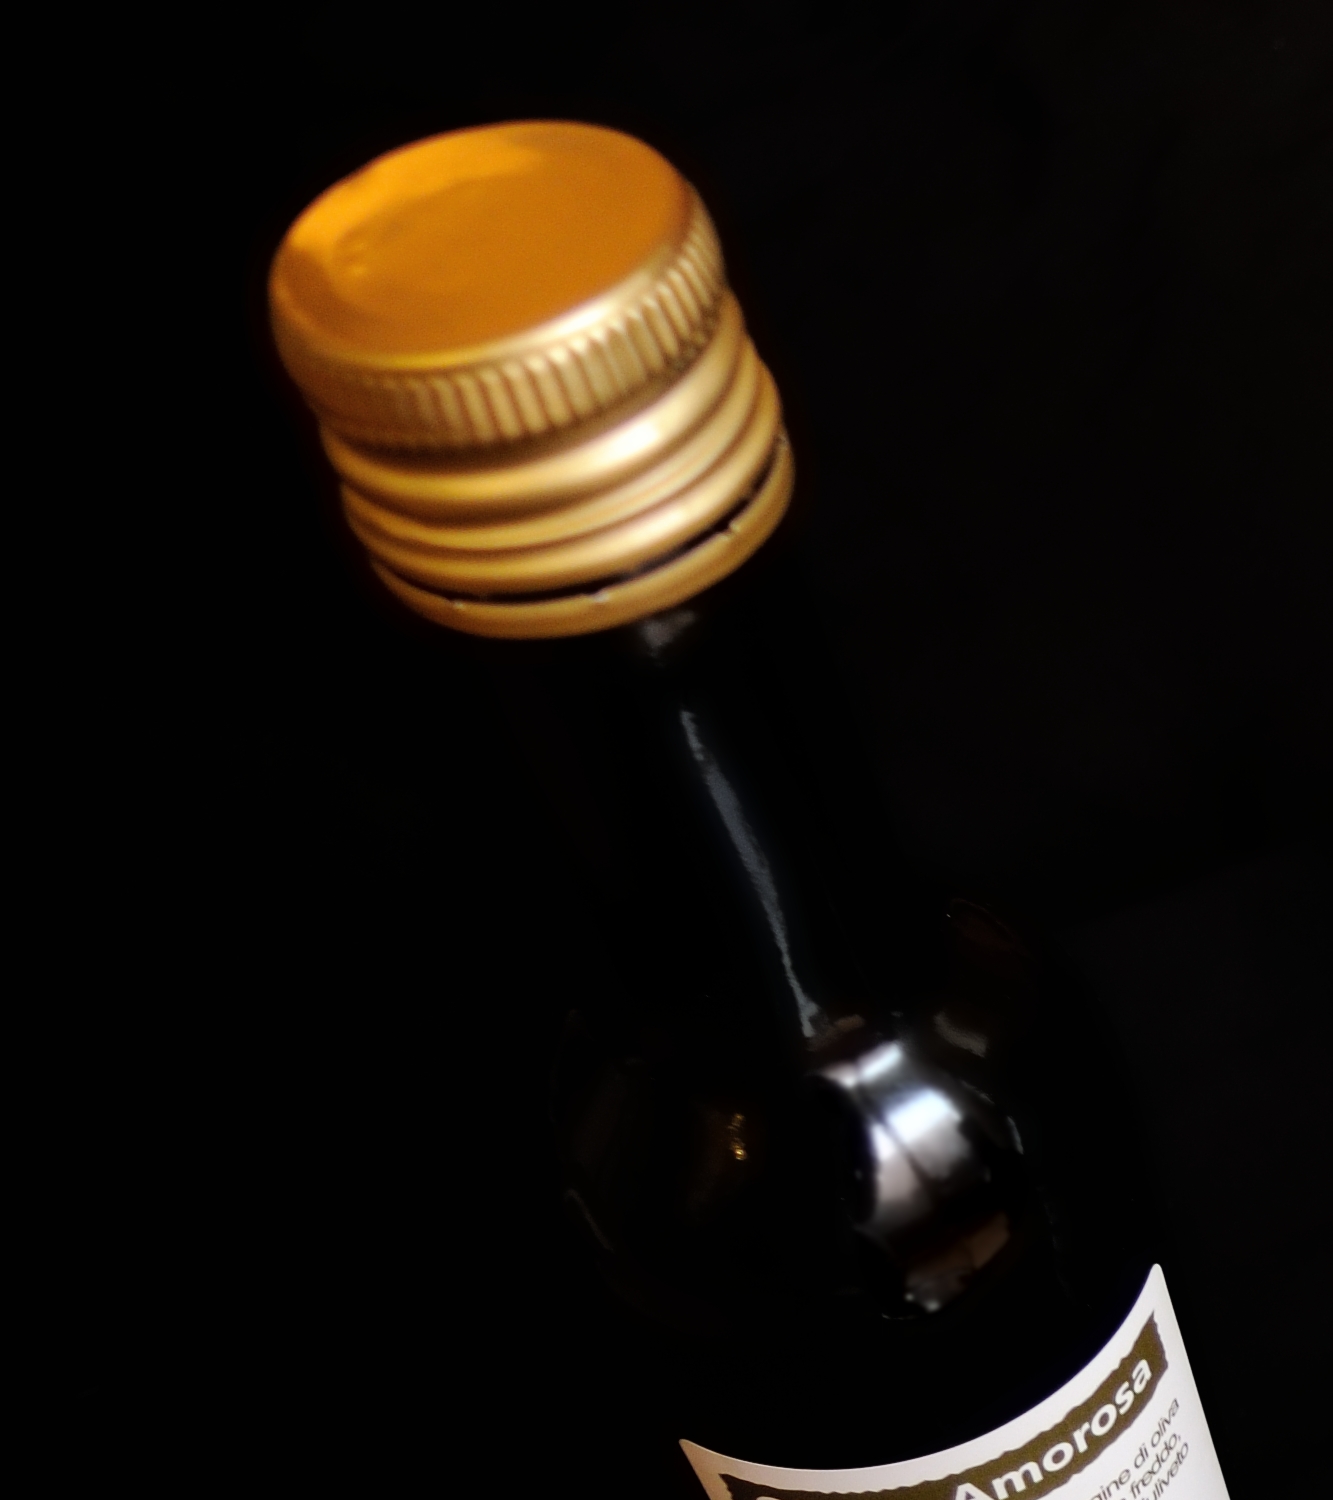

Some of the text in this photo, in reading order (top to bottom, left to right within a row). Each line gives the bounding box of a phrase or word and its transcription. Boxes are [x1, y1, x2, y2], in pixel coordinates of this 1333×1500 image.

[1130, 1433, 1182, 1498] freddo,
[1133, 1442, 1148, 1469] di
[1150, 1398, 1179, 1449] oliva
